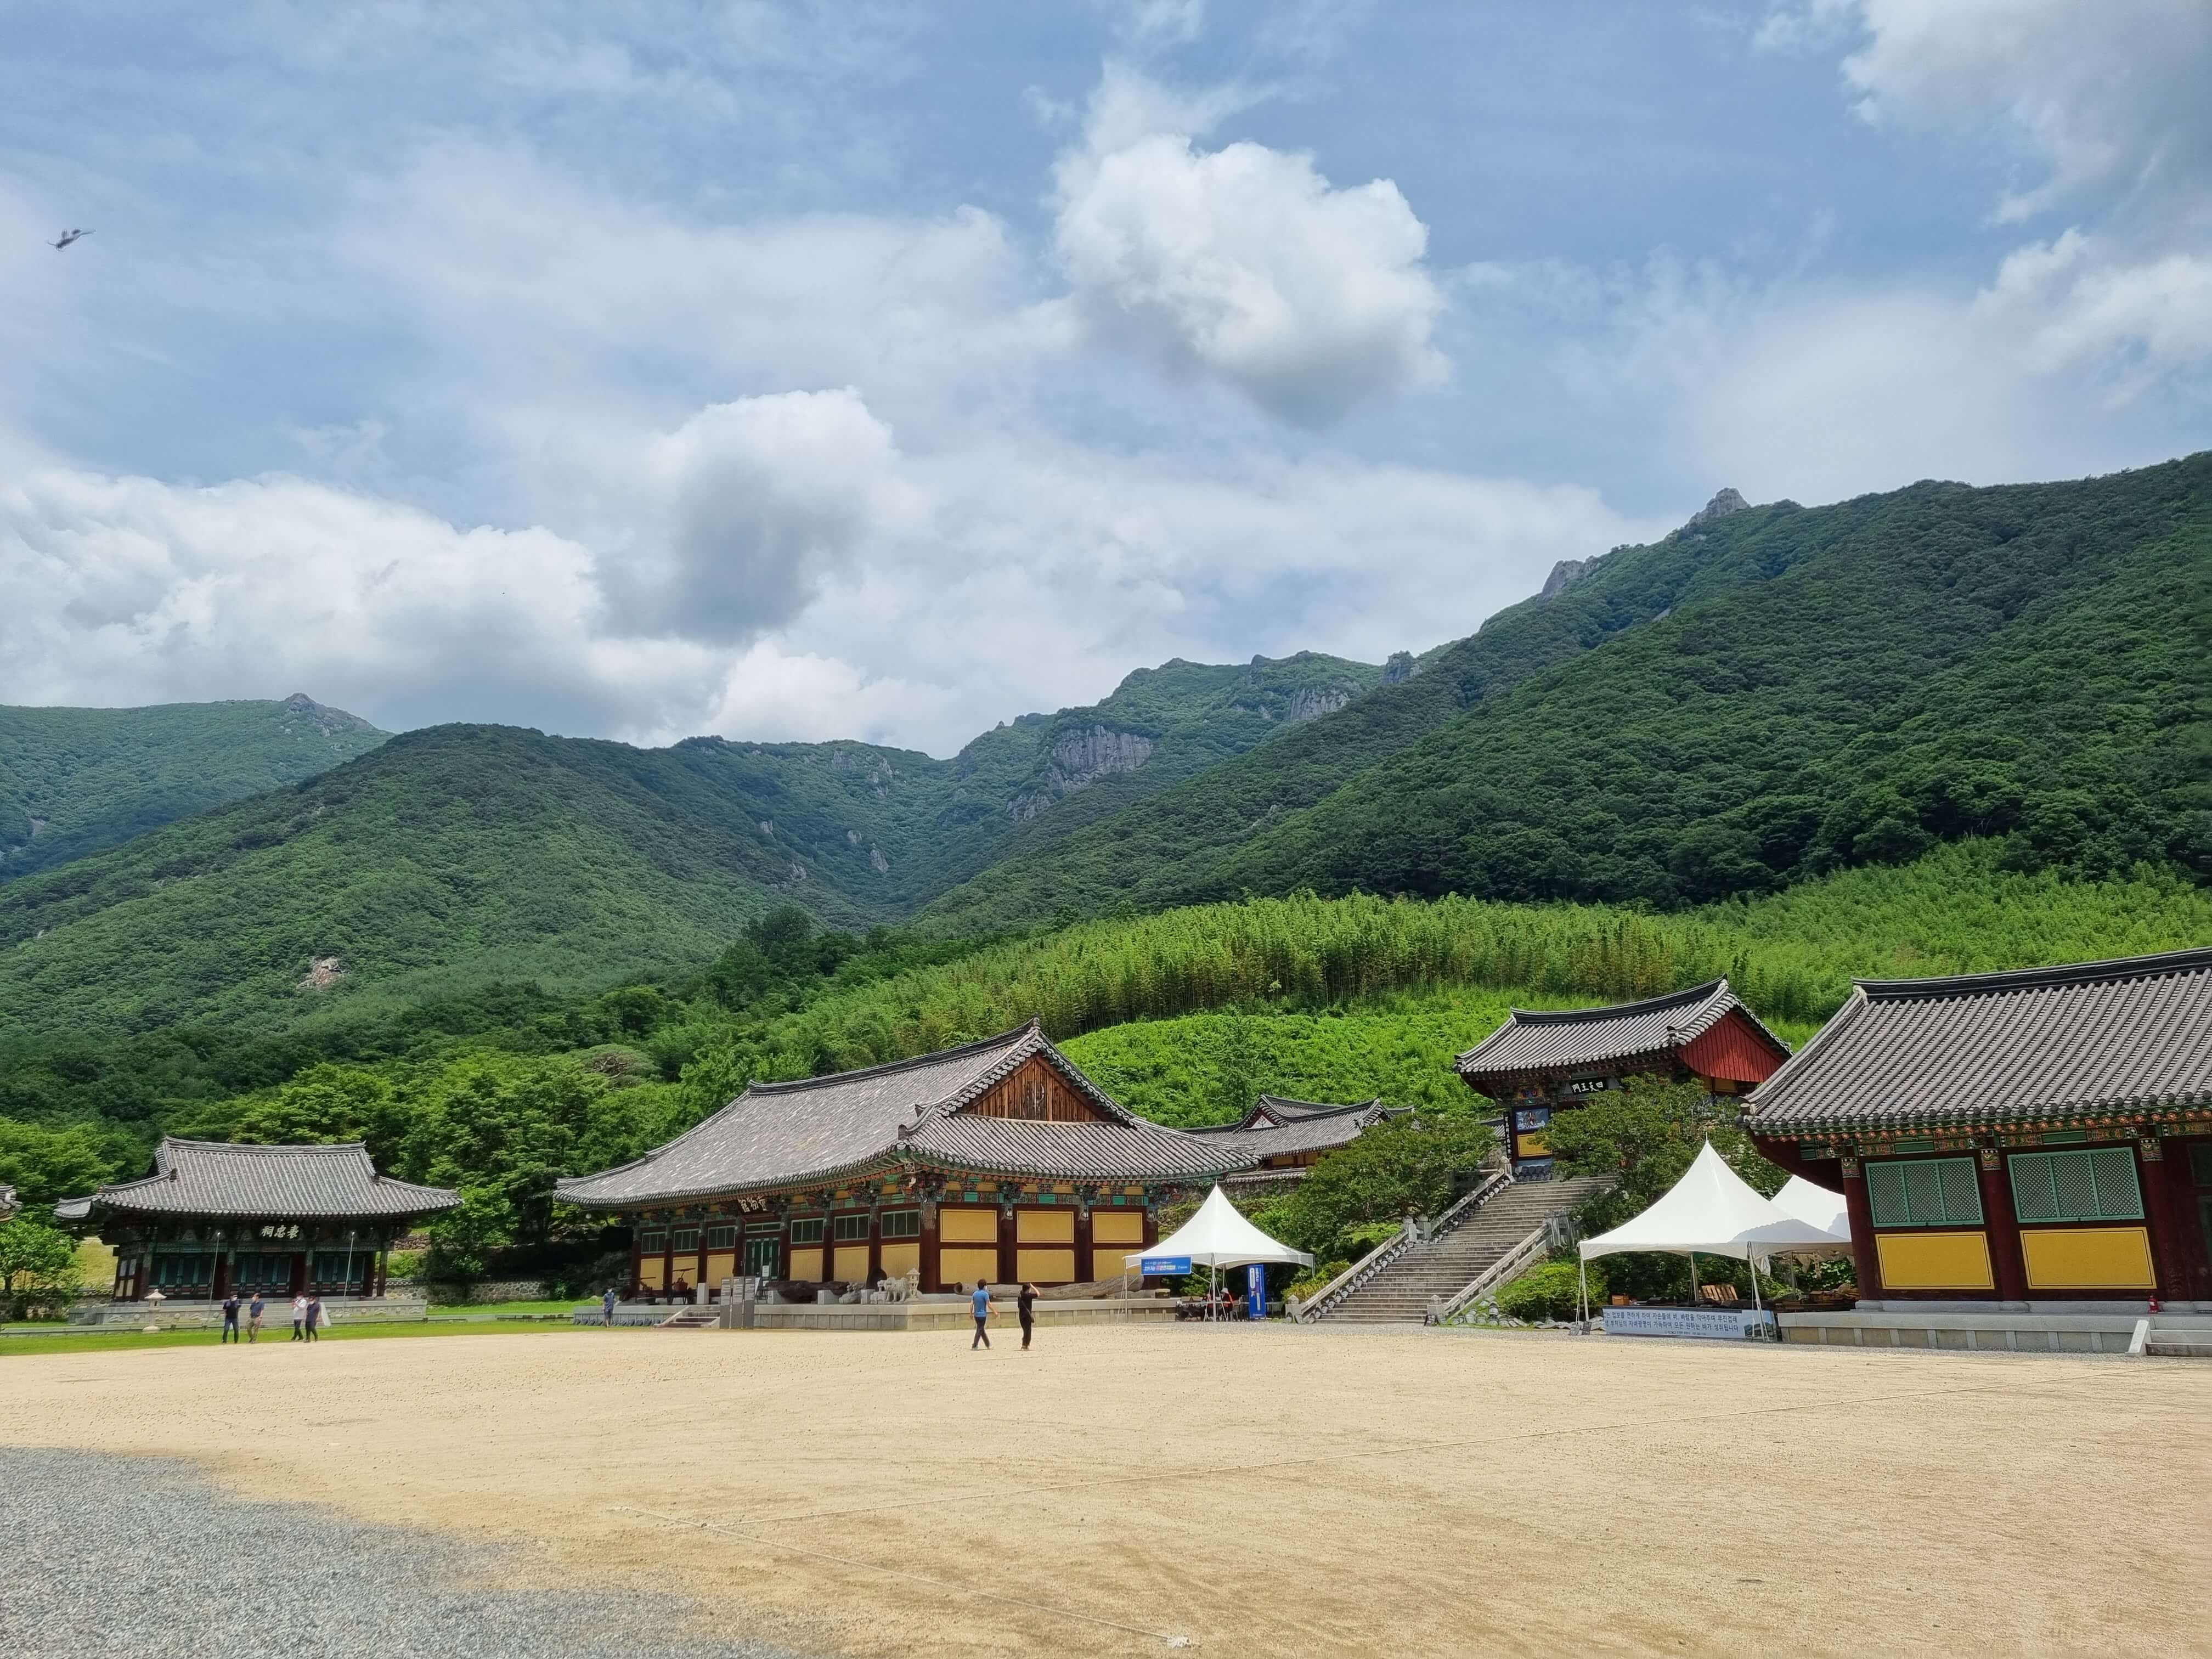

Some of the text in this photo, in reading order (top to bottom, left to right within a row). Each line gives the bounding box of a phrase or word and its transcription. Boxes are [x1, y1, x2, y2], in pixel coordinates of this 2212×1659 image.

[1680, 1313, 1695, 1321] 바람을
[1686, 1322, 1700, 1330] 원하는
[1714, 1324, 1739, 1332] 성취됩니다
